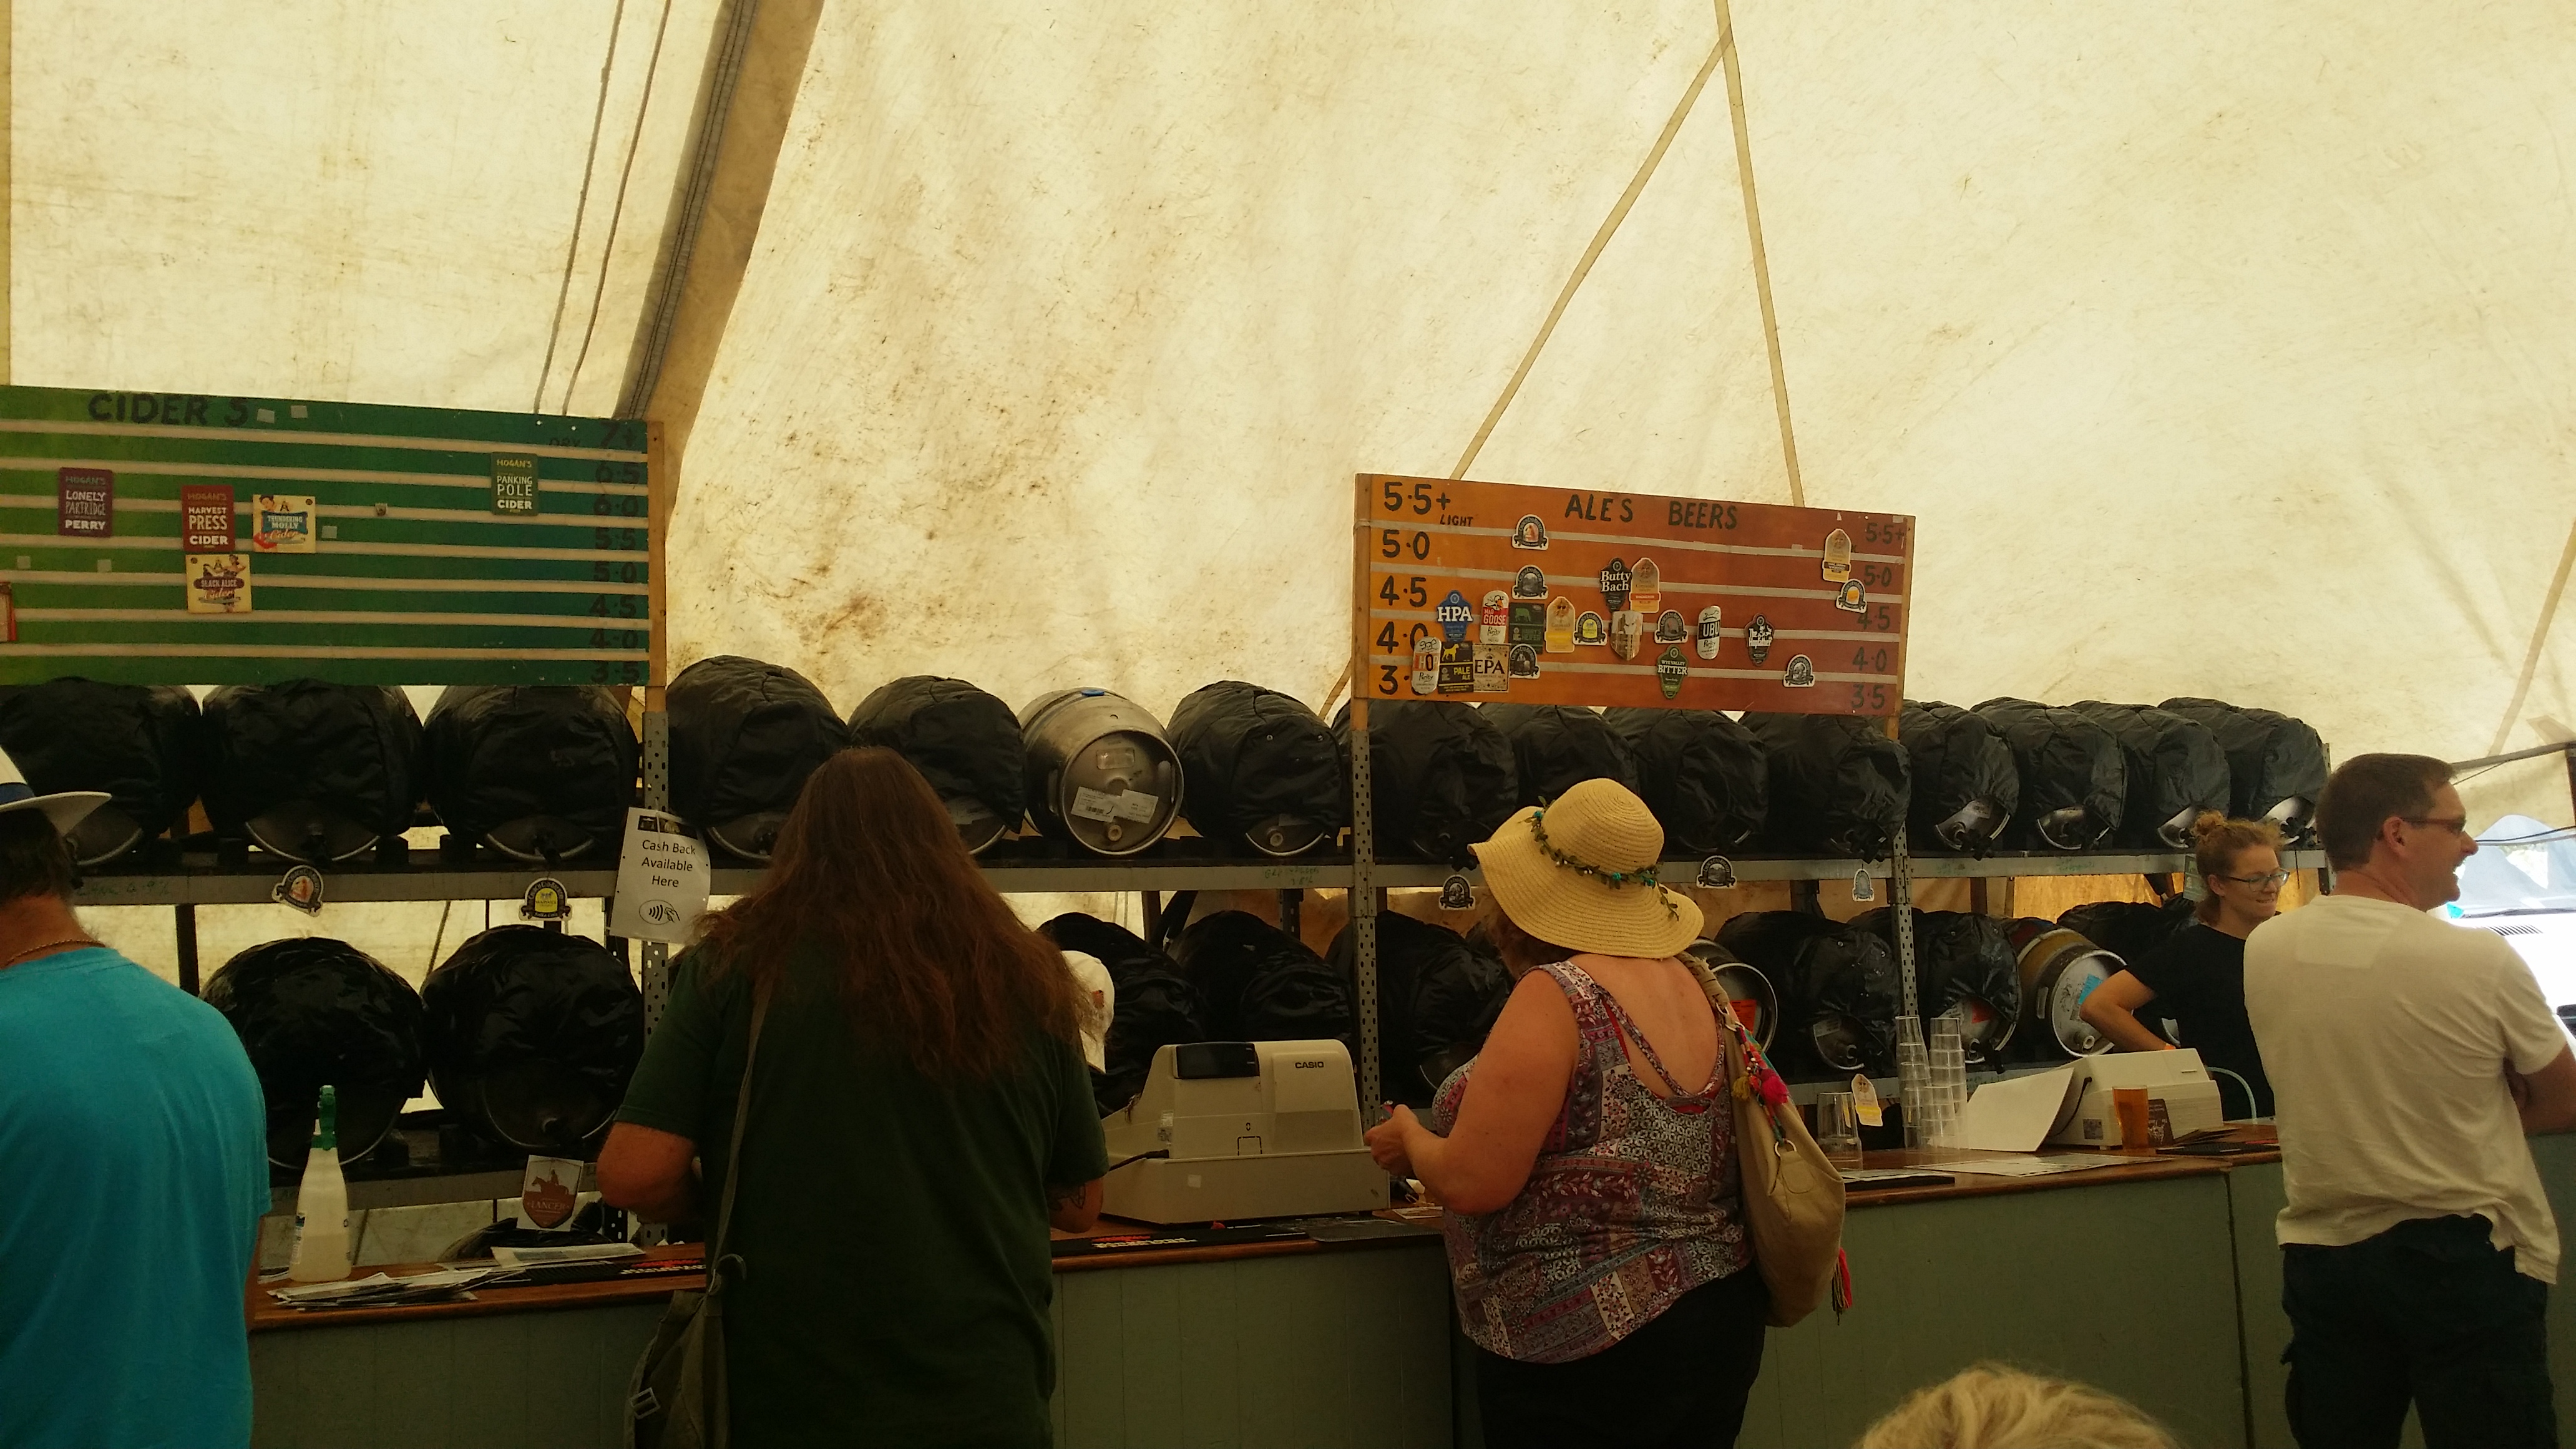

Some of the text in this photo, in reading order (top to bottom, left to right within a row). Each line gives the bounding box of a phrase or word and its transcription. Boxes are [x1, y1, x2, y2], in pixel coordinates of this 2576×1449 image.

[497, 459, 532, 467] HOGAN'S
[497, 476, 533, 485] PANKING
[66, 490, 107, 502] LONELY
[497, 484, 533, 496] POLE
[66, 501, 106, 516] PARTRIDGE
[497, 500, 533, 510] CIDER
[1564, 494, 1738, 530] ALES BEERS
[65, 519, 106, 530] PERRY
[189, 515, 227, 530] PRESS
[272, 522, 299, 530] MOLLY
[1440, 514, 1474, 527] LIGHT
[189, 535, 229, 545] CIDER
[1600, 570, 1632, 582] Butty
[1601, 580, 1629, 592] Bach
[1437, 605, 1473, 623] HPA
[1483, 614, 1506, 625] GOOSE
[1702, 620, 1720, 637] UBU
[1419, 653, 1438, 671] HOP
[1475, 660, 1505, 674] EPA
[1453, 666, 1471, 675] PALE
[1657, 664, 1688, 675] BITTER
[642, 839, 696, 855] Cash Back
[641, 857, 693, 872] Available
[651, 875, 679, 887] Here
[1295, 1061, 1324, 1069] CASIO
